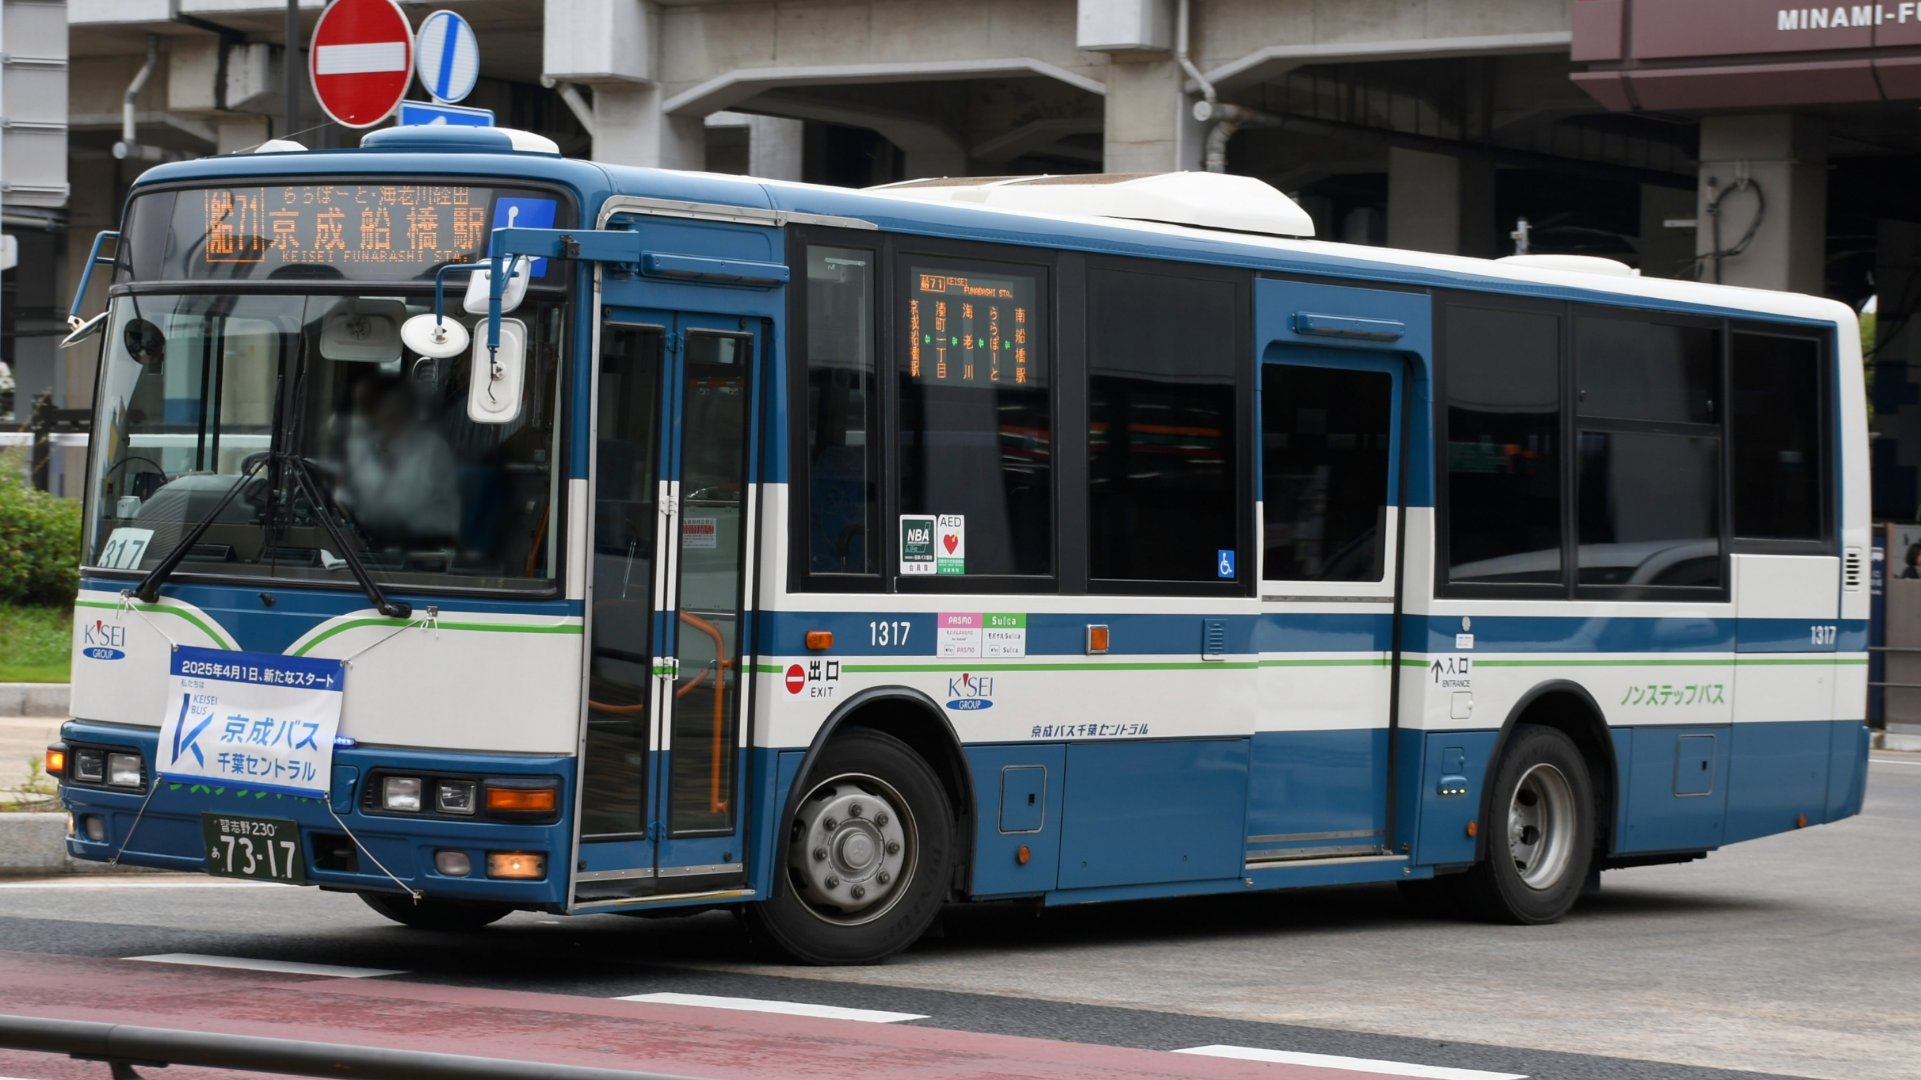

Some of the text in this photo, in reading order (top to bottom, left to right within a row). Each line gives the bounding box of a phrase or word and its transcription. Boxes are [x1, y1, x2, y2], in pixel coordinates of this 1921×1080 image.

[1777, 2, 1921, 30] MINAMI-F
[269, 206, 486, 250] 京成船橋駅
[282, 250, 334, 262] KEISEI
[343, 250, 424, 262] FUNABASHI
[962, 303, 974, 380] 海老川
[1015, 307, 1026, 384] 南船橋駅
[940, 516, 962, 528] AED
[907, 528, 930, 542] NBA
[101, 539, 146, 569] 317
[948, 616, 972, 625] PASMO
[991, 616, 1017, 625] Suica
[869, 621, 911, 647] 1317
[1811, 626, 1837, 645] 1317
[92, 648, 114, 659] GROUP
[181, 660, 334, 688] 2025年4月1日、新たなスタート
[808, 660, 839, 682] 出口
[1446, 657, 1468, 675] 入口
[810, 686, 835, 698] EXIT
[1442, 679, 1471, 688] ENTRANCE
[193, 693, 218, 706] KEISEI
[1620, 684, 1724, 706] ノンステップバス
[191, 705, 208, 715] BUS
[958, 700, 981, 710] GROUP
[220, 714, 320, 752] 京成バス
[1031, 723, 1149, 738] 京成バス千葉セントラル
[217, 752, 316, 782] 千葉セントラル
[211, 835, 296, 879] あ 73-17
